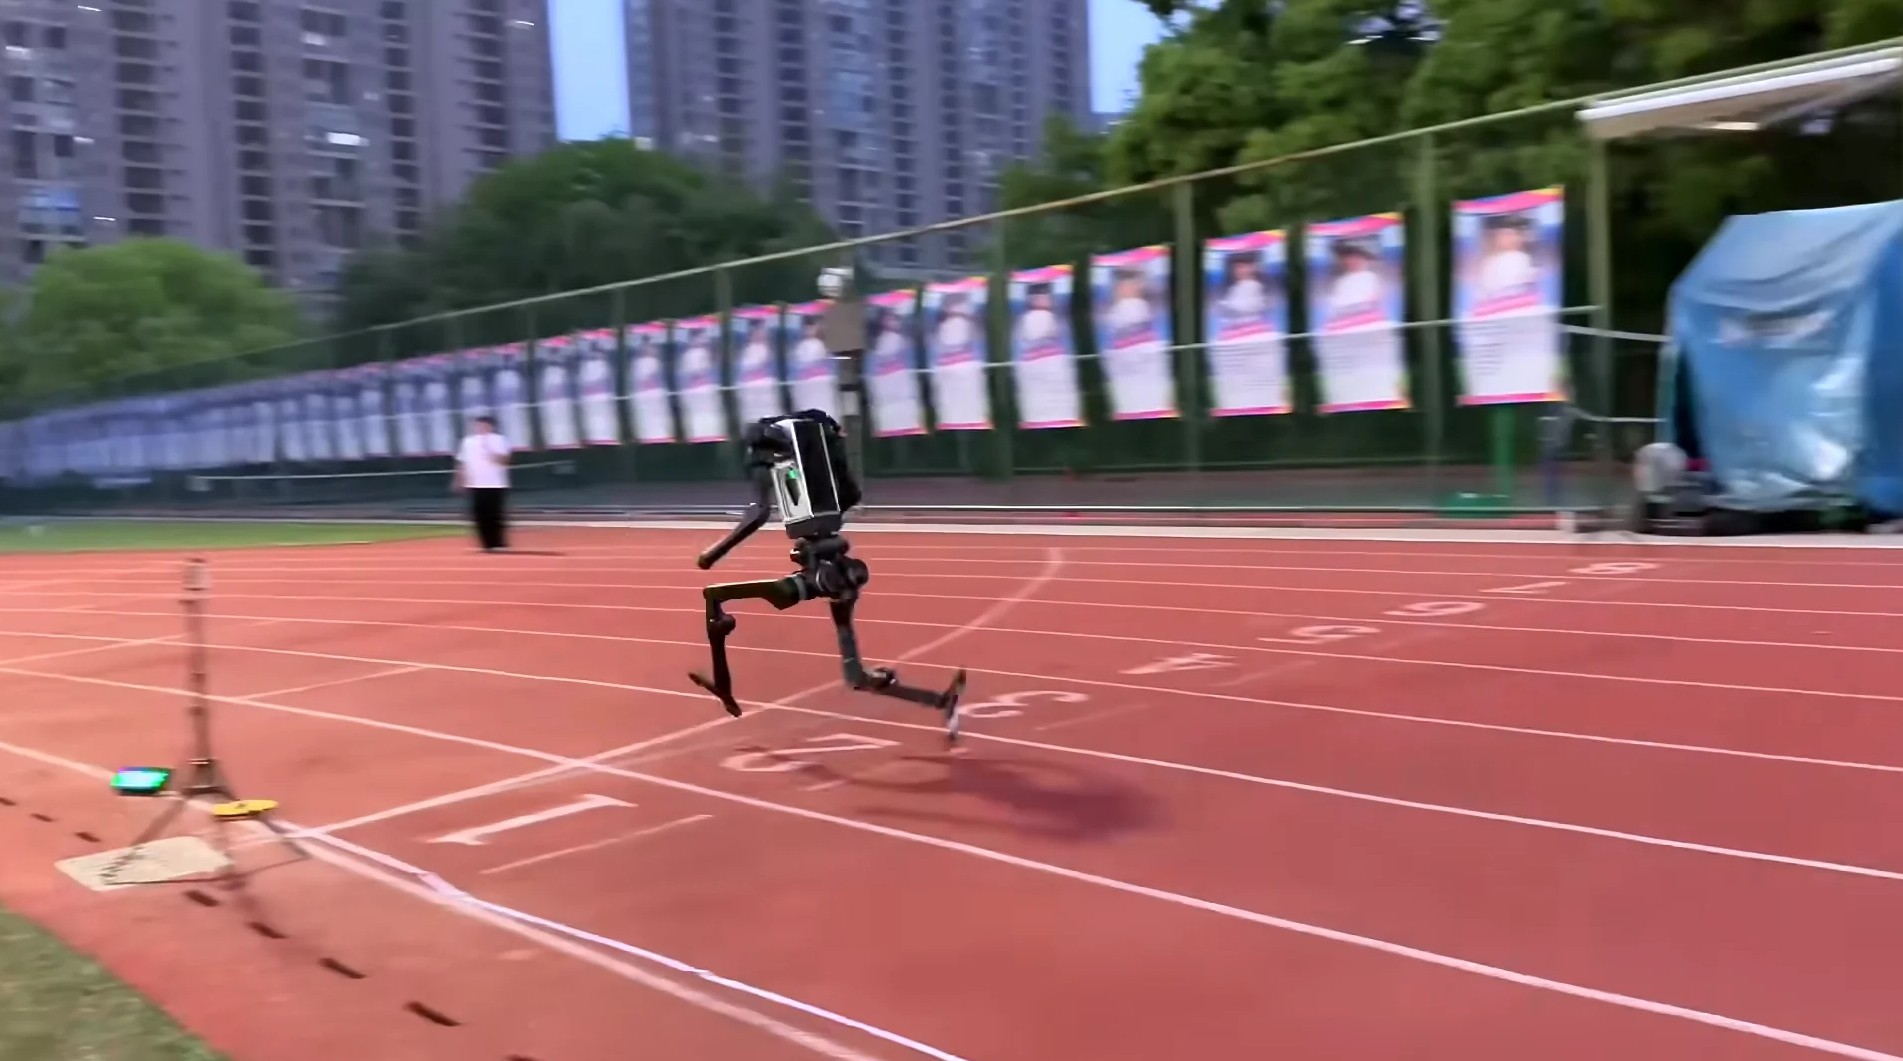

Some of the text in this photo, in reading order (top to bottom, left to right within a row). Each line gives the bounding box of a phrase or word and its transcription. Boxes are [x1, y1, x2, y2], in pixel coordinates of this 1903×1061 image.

[1567, 561, 1661, 575] 8
[1381, 600, 1487, 617] 6
[1255, 624, 1383, 645] 5
[1116, 651, 1240, 675] 4
[956, 689, 1091, 719] 3
[719, 732, 902, 772] 2
[424, 793, 640, 846] 1
